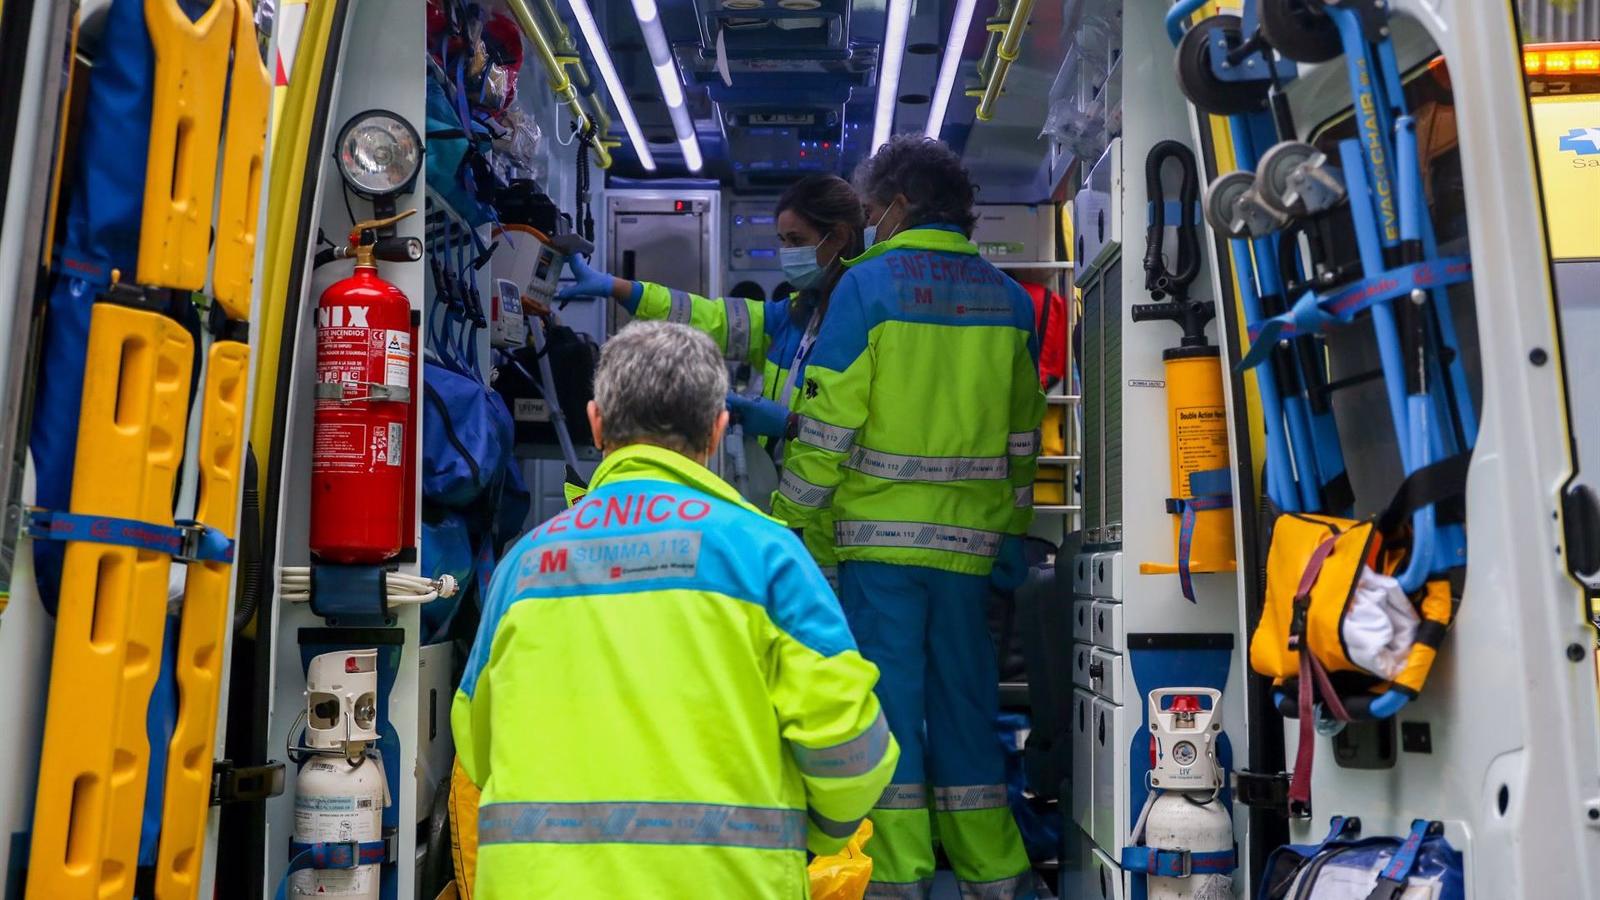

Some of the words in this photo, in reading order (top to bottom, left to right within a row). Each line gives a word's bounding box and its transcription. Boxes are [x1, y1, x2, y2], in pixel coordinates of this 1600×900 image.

[1181, 412, 1197, 420] Double
[803, 426, 825, 439] SUMMA
[864, 458, 885, 469] SUMMA
[887, 463, 899, 471] 112
[920, 465, 943, 473] SUMMA
[540, 549, 567, 573] M
[575, 545, 650, 562] SUMMA
[659, 539, 690, 556] 112
[1179, 768, 1191, 776] LIV
[546, 818, 583, 828] SUMMA
[636, 817, 672, 829] SUMMA
